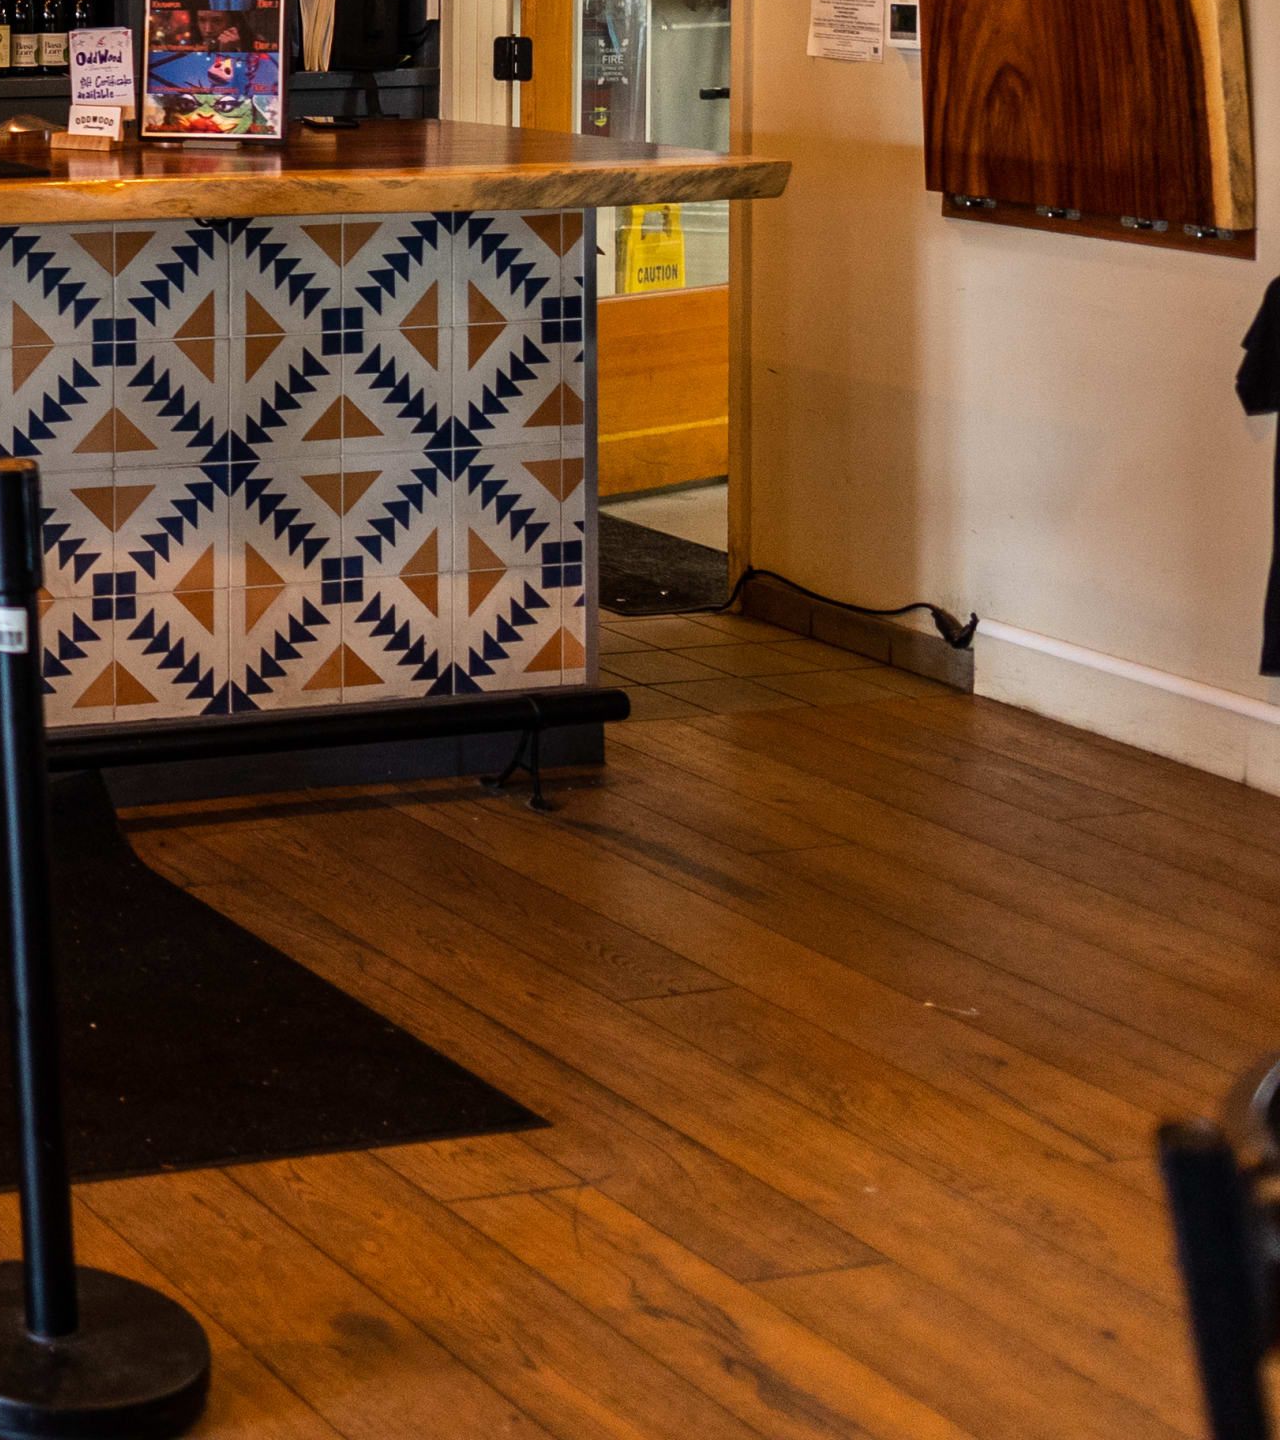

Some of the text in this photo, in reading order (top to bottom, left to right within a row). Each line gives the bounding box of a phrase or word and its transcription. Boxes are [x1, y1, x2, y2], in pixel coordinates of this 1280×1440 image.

[602, 55, 623, 64] FIRE
[78, 88, 114, 99] available
[76, 116, 113, 126] ODDWOOD
[638, 264, 678, 283] CAUTION
